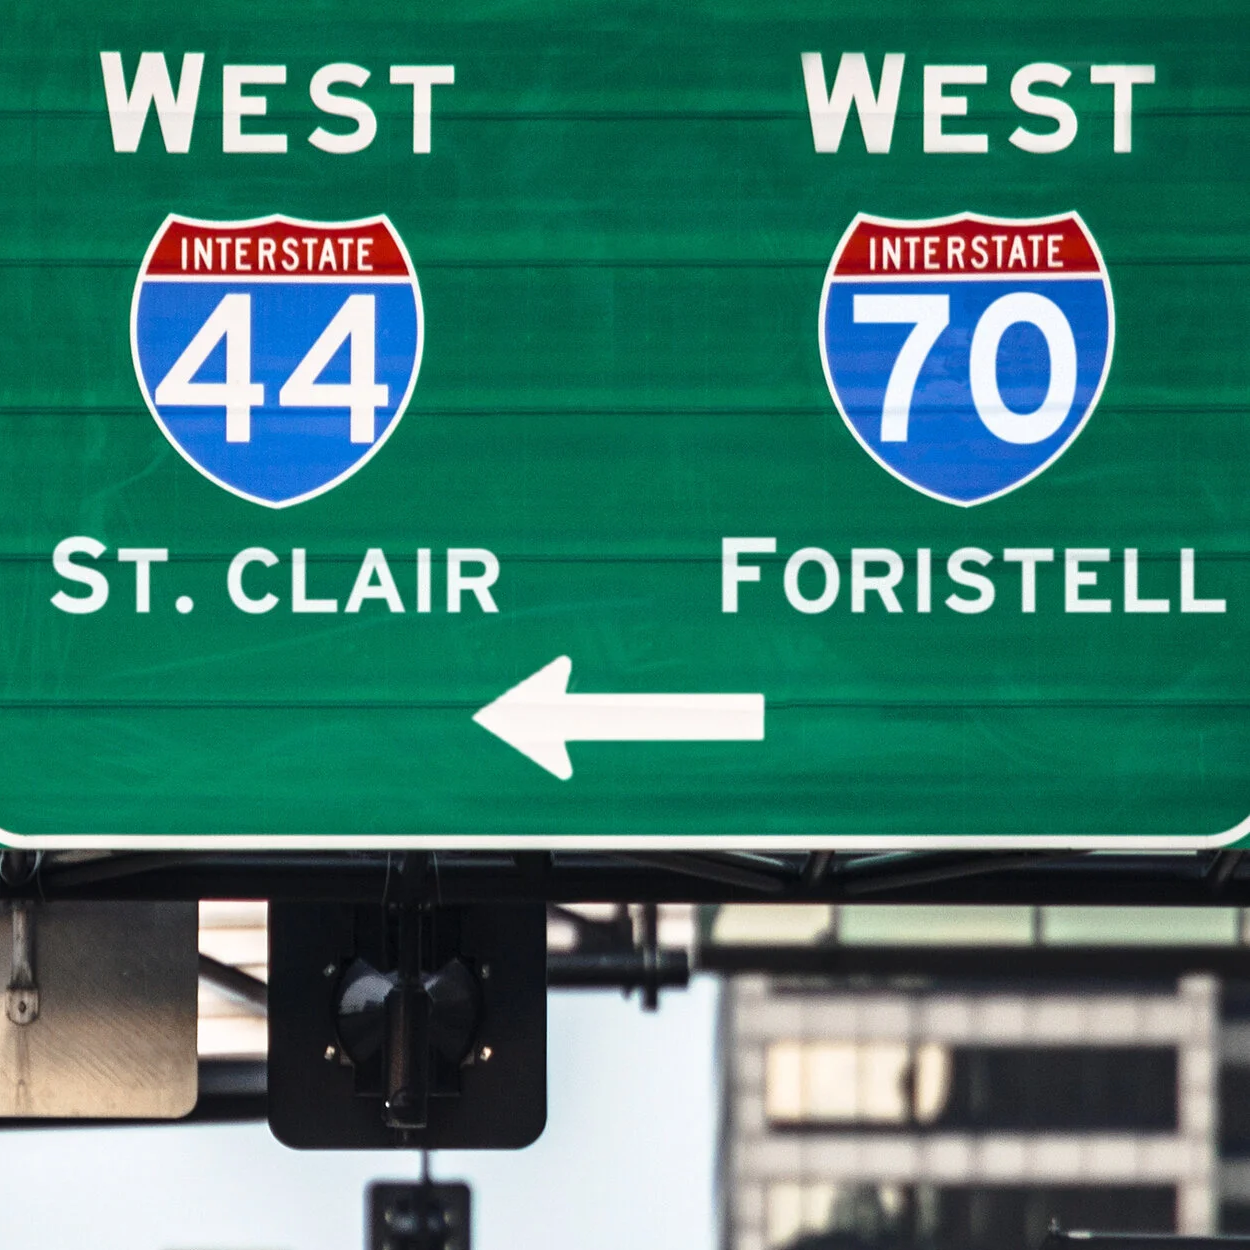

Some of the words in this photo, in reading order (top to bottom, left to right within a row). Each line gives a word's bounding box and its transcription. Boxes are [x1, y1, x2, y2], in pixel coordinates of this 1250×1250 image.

[100, 51, 455, 154] WEST
[801, 51, 1156, 154] WEST
[180, 237, 374, 272] INTERSTATE
[869, 234, 1065, 271] INTERSTATE
[154, 293, 389, 444] 44
[852, 291, 1078, 446] 70
[50, 536, 194, 614] ST.
[226, 547, 500, 614] CLAIR
[721, 536, 1227, 614] FORISTELL
